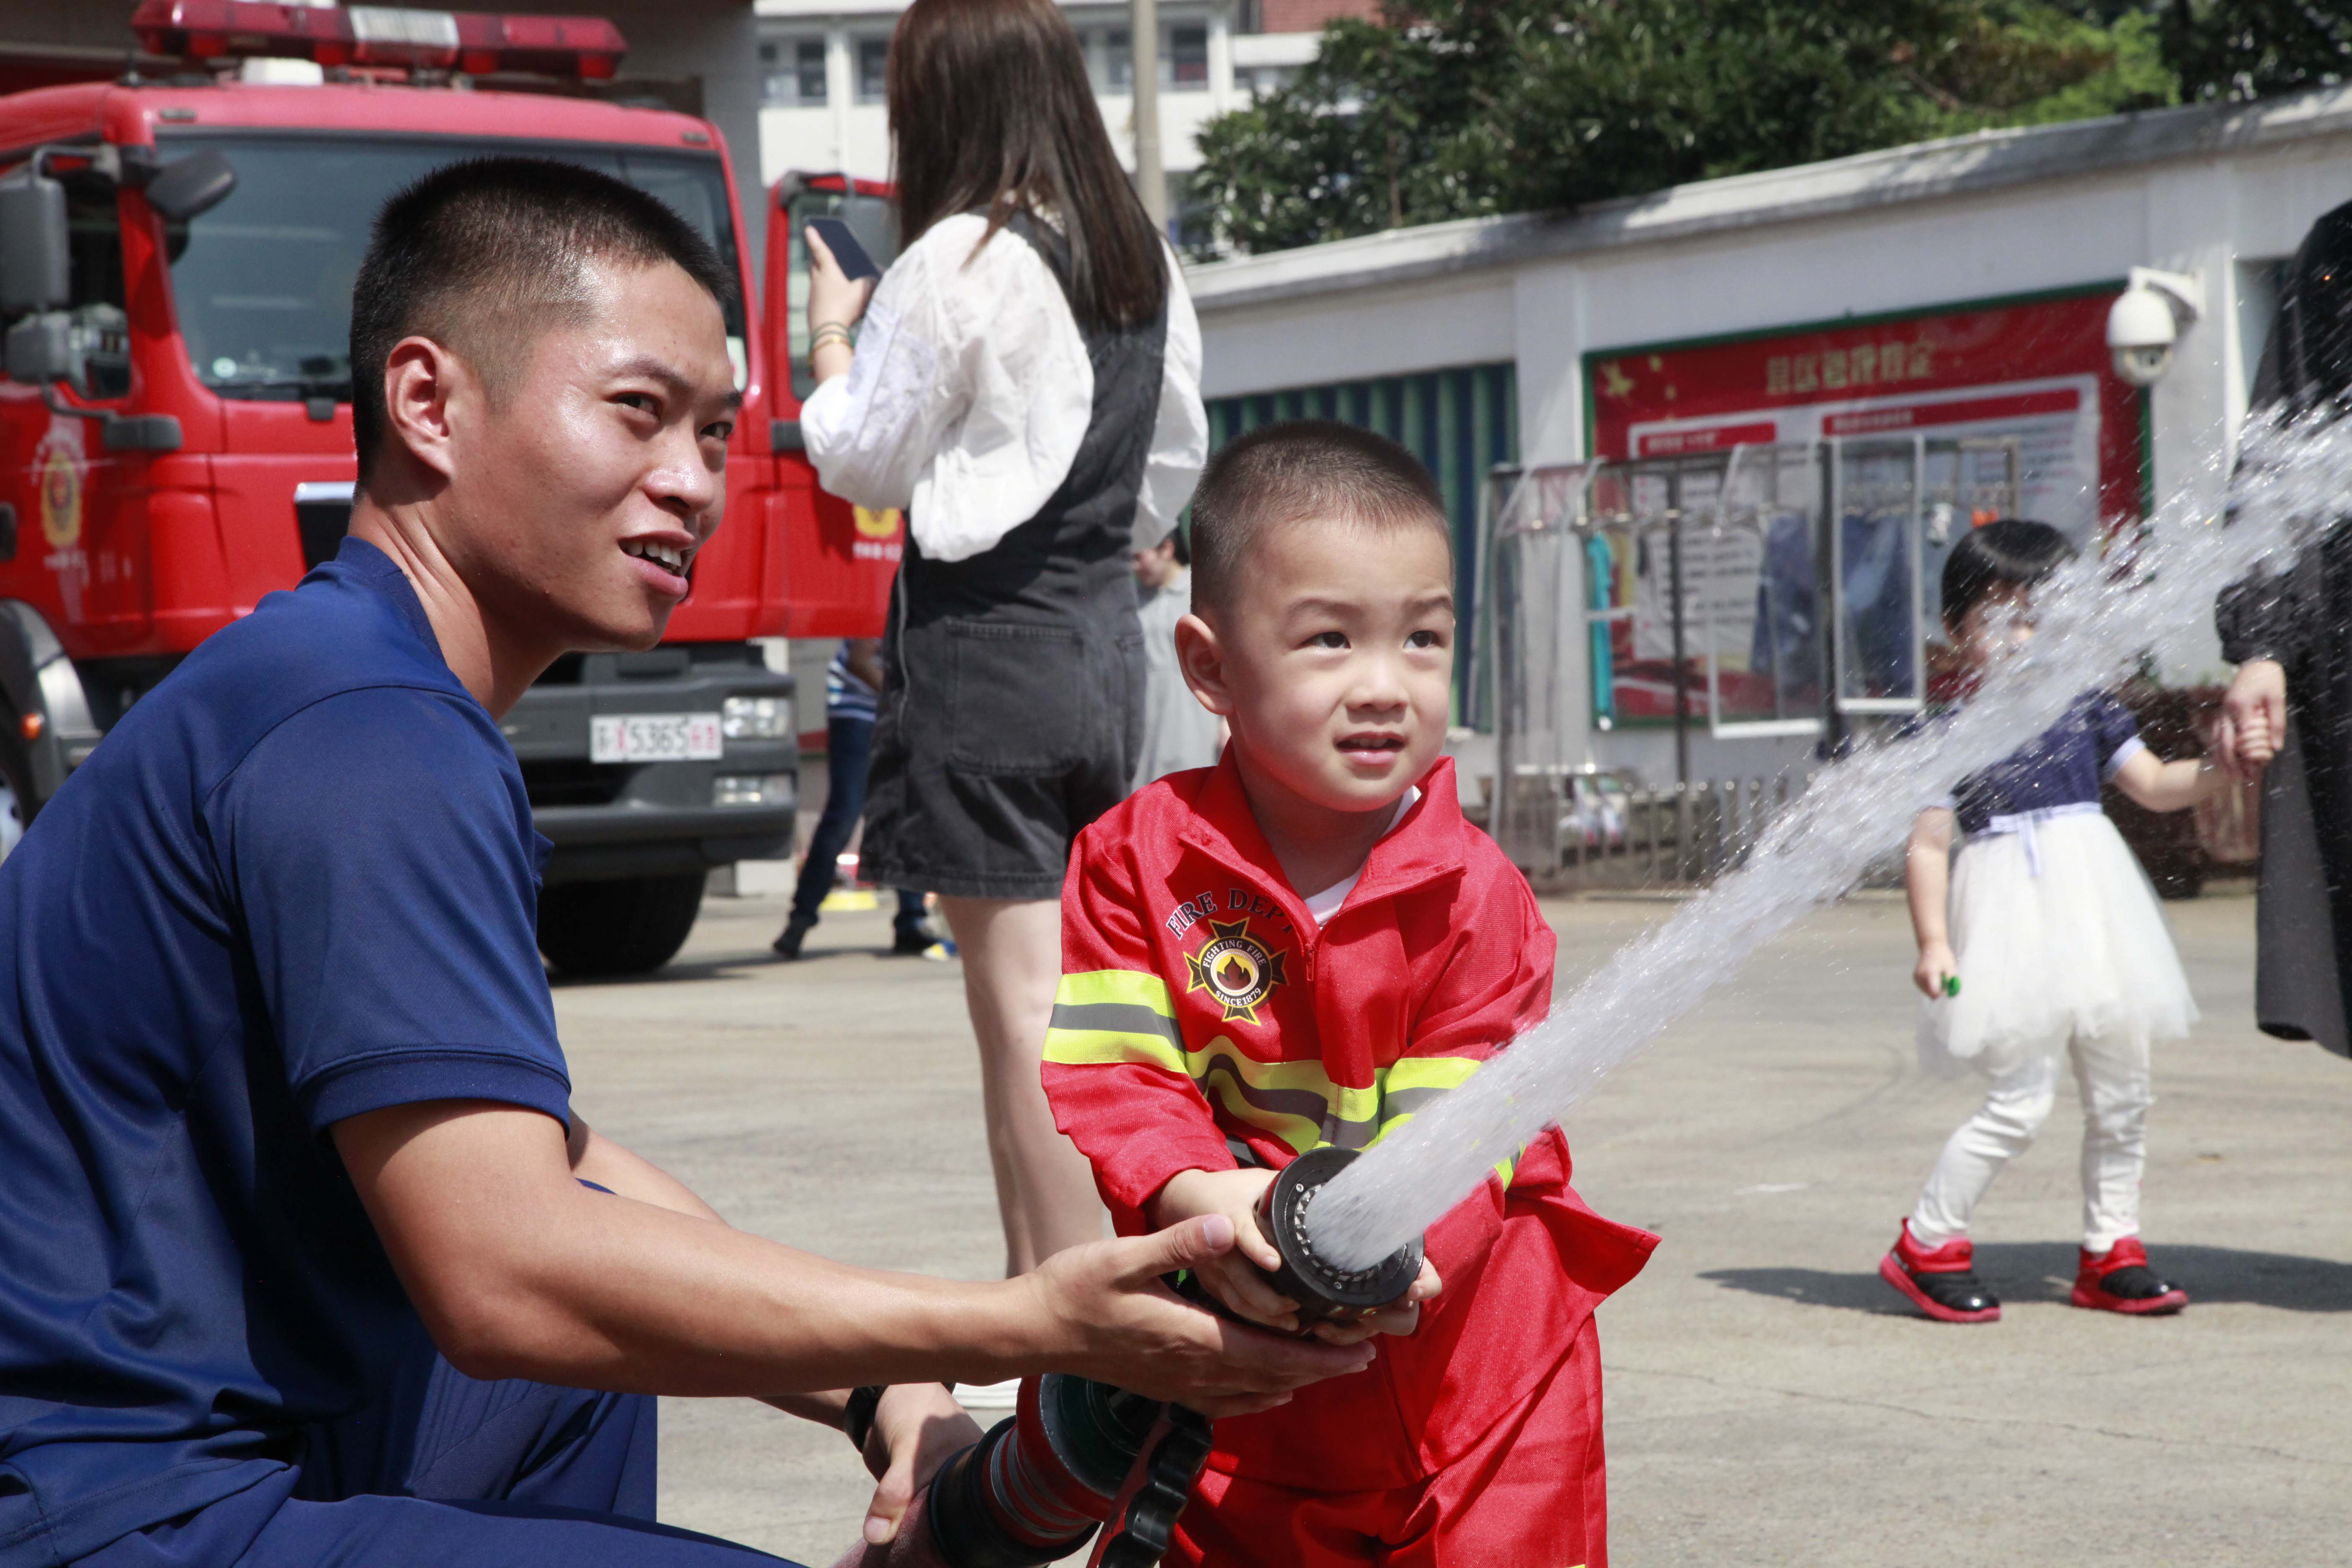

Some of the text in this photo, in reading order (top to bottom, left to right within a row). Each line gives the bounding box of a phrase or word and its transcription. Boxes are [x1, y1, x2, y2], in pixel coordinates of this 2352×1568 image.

[1166, 891, 1218, 940] FIRE
[1202, 939, 1267, 968] FIGHTING FIRE
